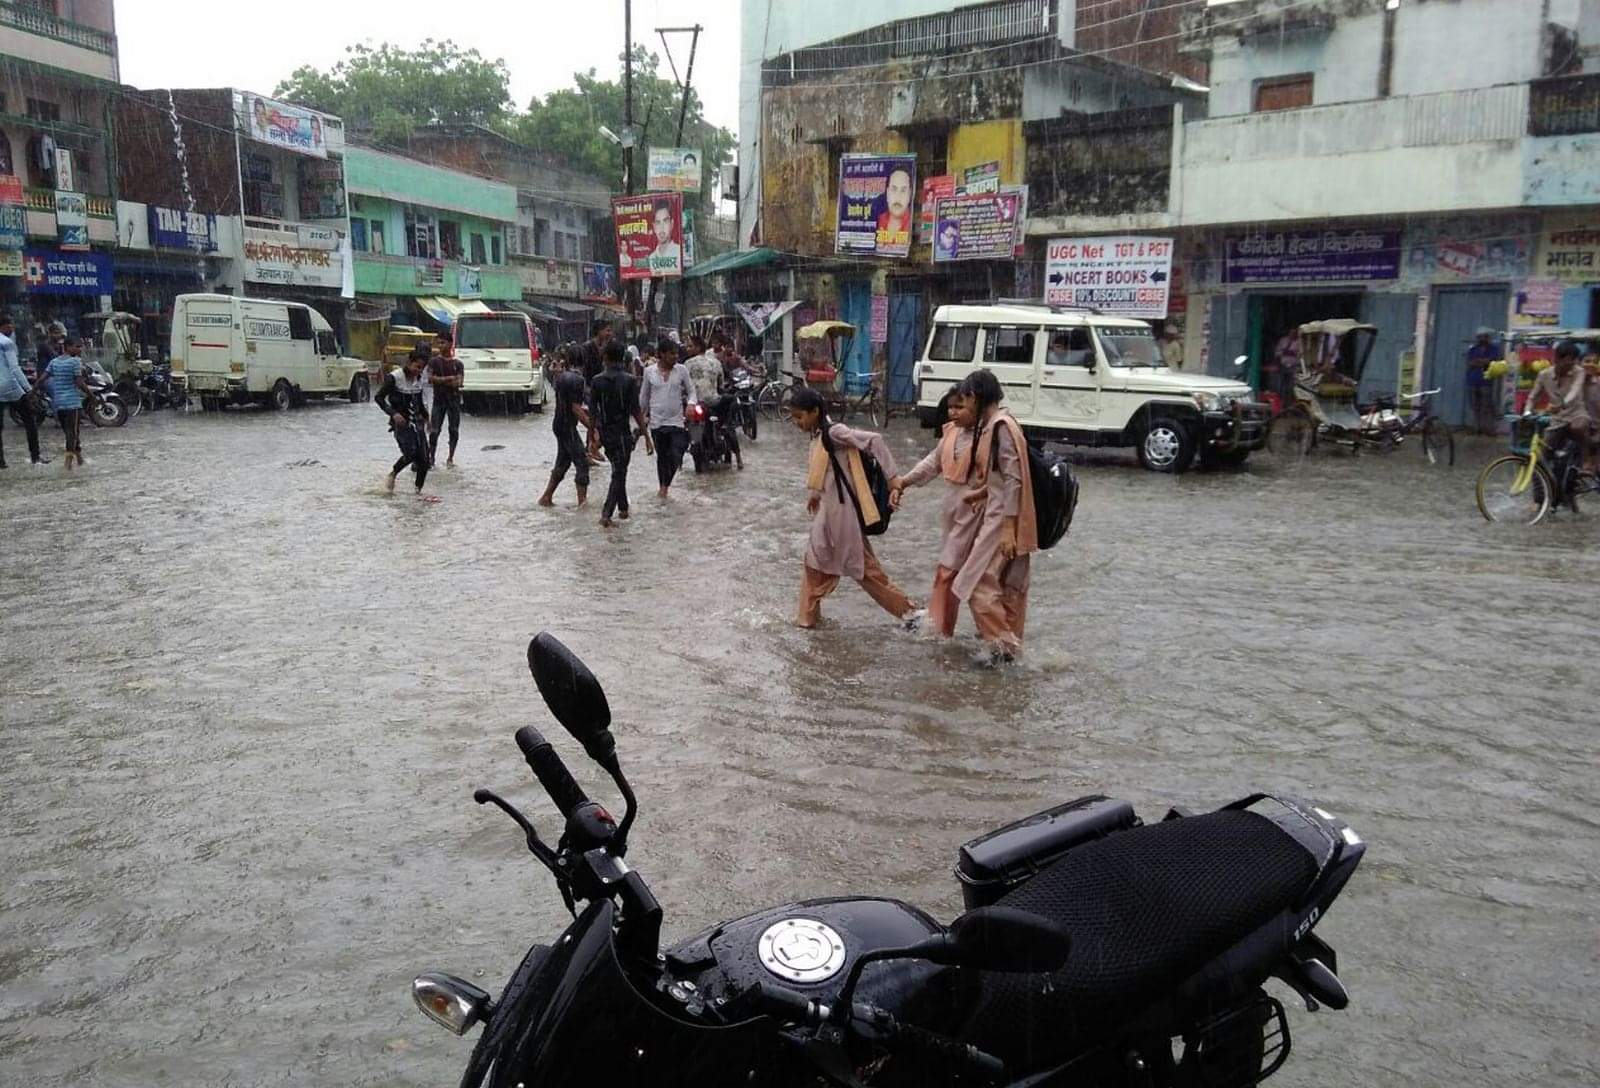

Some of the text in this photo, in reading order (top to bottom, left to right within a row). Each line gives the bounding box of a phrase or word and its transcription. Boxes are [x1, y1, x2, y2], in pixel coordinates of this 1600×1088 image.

[1050, 245, 1077, 259] UGC
[1082, 244, 1104, 258] Net
[1115, 243, 1134, 257] TGT
[1148, 242, 1169, 257] PGT
[48, 275, 98, 287] HDFC BANK
[1064, 270, 1147, 285] NCERT BOOKS
[1048, 289, 1073, 302] CBSE
[1093, 289, 1136, 302] DISCOUNT
[1137, 289, 1165, 302] CBSE
[1294, 907, 1319, 941] 150
